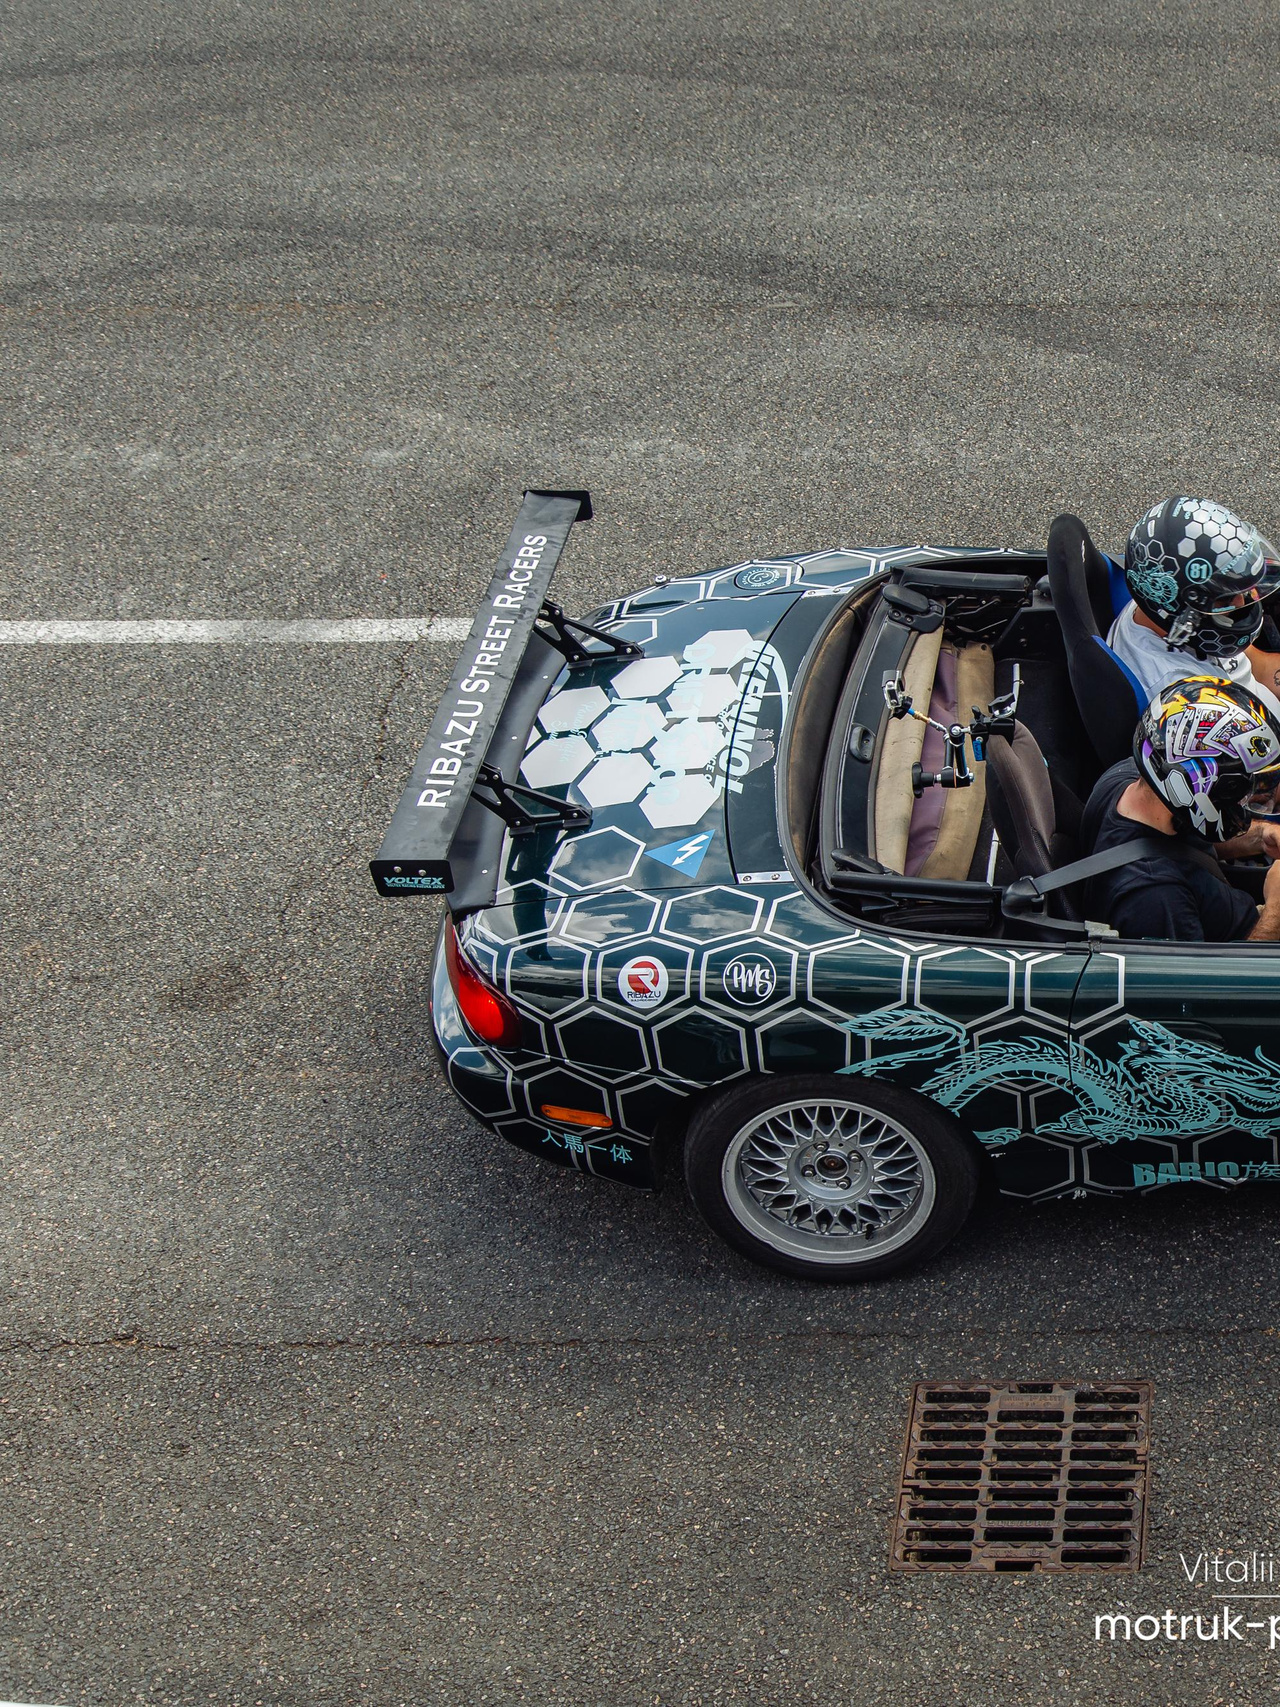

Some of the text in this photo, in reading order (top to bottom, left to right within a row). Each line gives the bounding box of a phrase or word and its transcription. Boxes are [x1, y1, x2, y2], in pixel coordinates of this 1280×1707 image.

[1190, 563, 1208, 579] 81
[417, 534, 548, 807] RIBAZU STREET RACERS
[713, 648, 776, 795] KENNOL
[383, 876, 444, 885] VOLTEX
[627, 990, 661, 999] RIBAZU
[726, 961, 773, 997] PMS
[541, 1129, 634, 1164] 人馬一体
